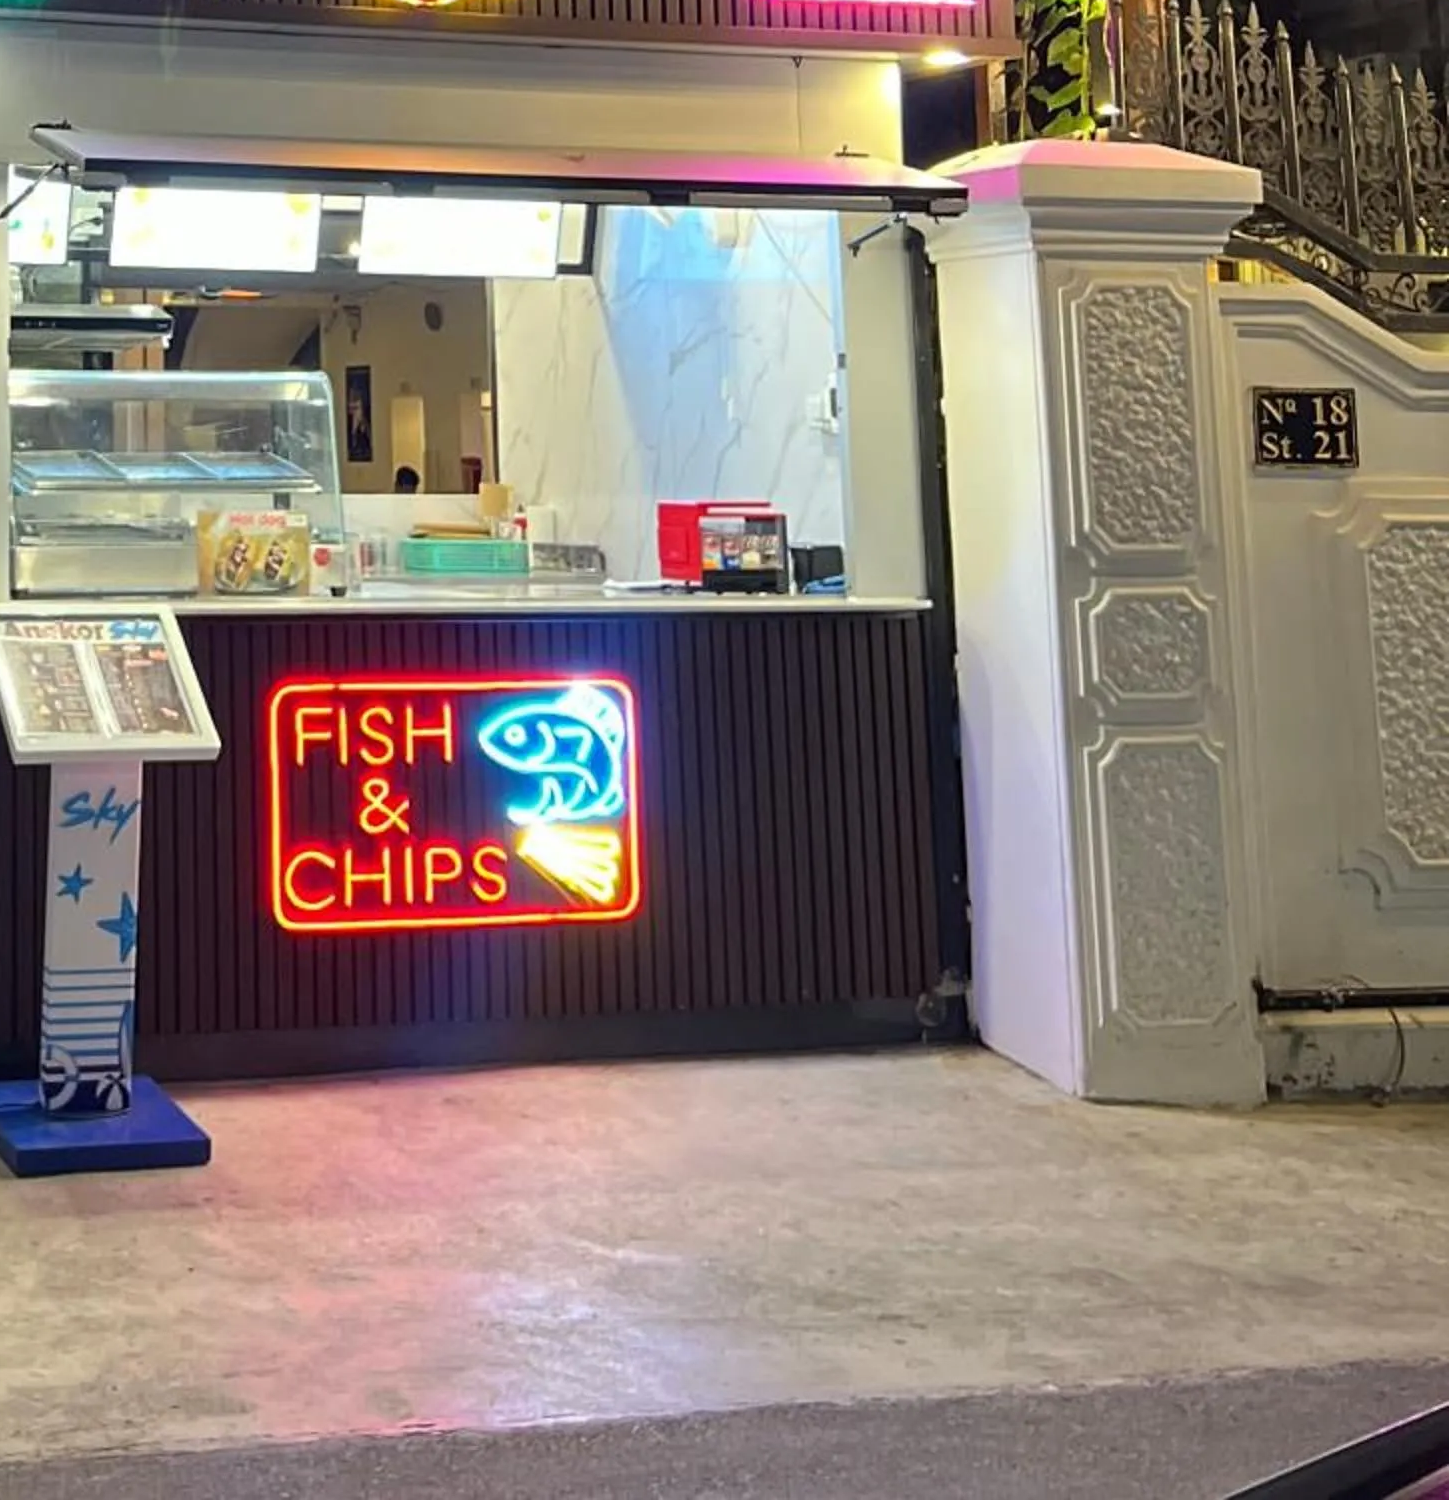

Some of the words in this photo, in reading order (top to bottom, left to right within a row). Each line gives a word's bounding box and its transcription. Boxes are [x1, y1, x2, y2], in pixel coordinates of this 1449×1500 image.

[1311, 395, 1350, 426] 18
[1261, 431, 1303, 460] St.
[1312, 430, 1350, 460] 21
[295, 702, 453, 767] FISH
[56, 786, 139, 845] Sky
[359, 777, 411, 835] &
[284, 845, 508, 911] CHIPS
